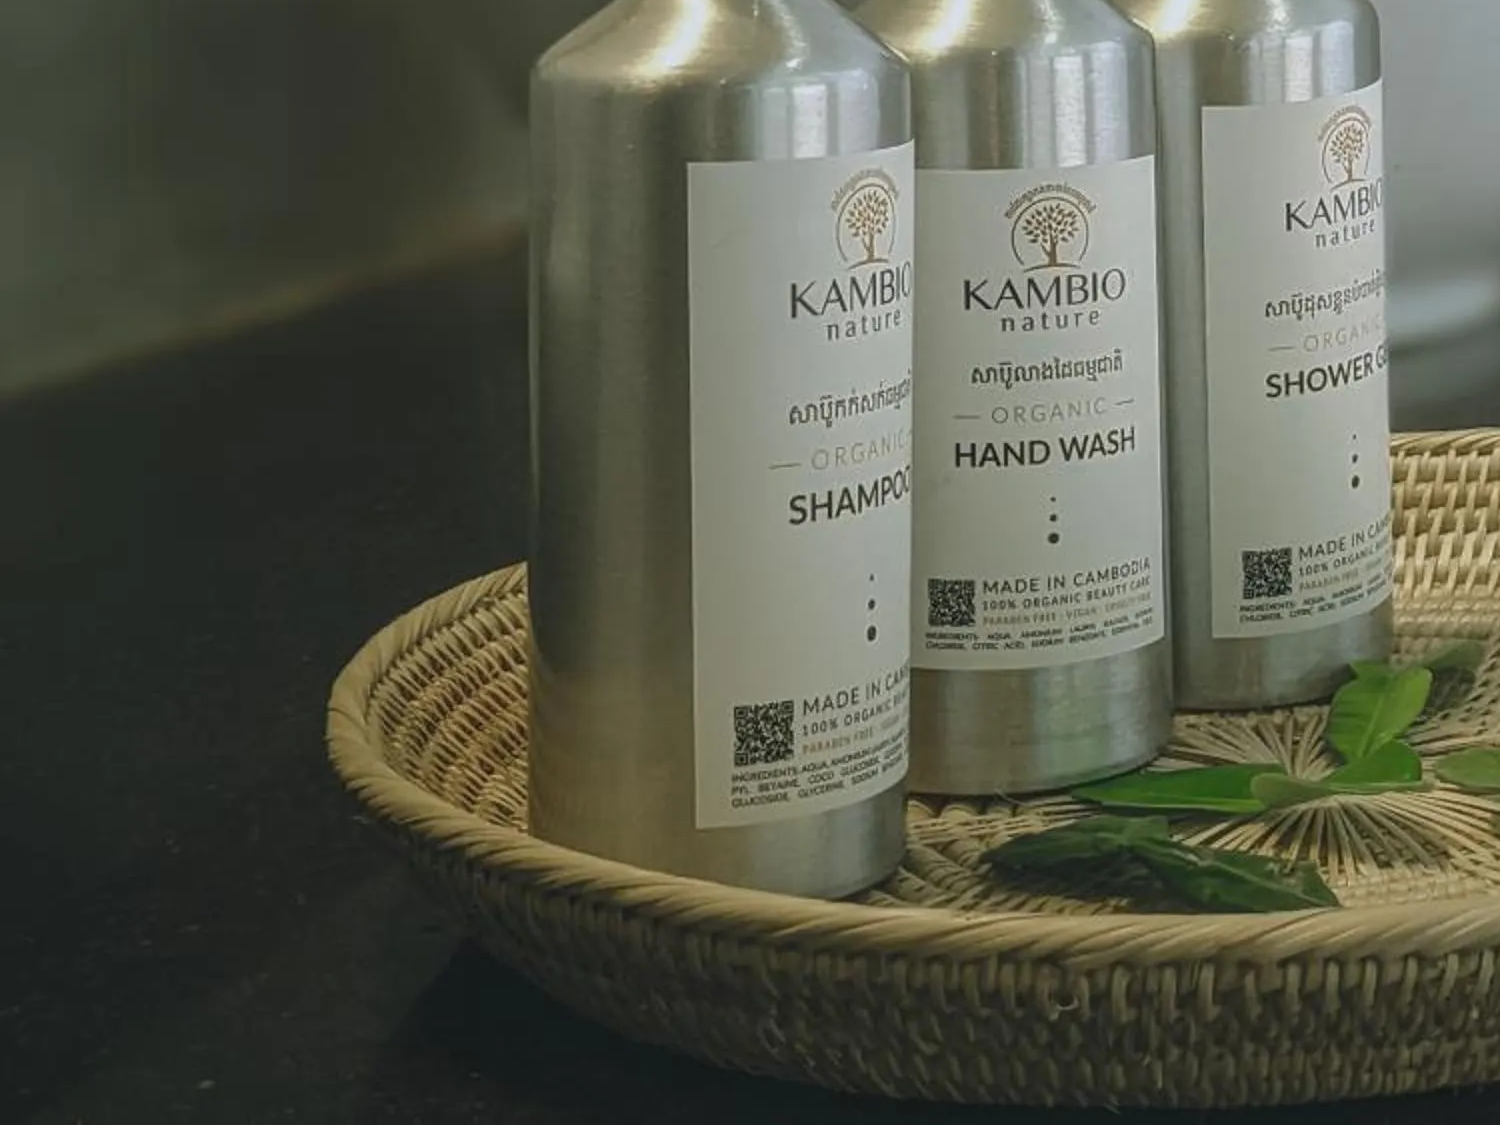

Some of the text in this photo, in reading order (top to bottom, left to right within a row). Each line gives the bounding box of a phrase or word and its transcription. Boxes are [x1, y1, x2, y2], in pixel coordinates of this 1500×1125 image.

[1315, 219, 1375, 248] nature
[963, 268, 1126, 311] KAMBIO
[826, 309, 901, 341] nature
[1001, 310, 1101, 332] nature
[1265, 352, 1374, 398] SHOWER
[991, 397, 1108, 424] ORGANIC
[955, 425, 1136, 468] HAND WASH
[1299, 536, 1347, 560] MADE
[1351, 530, 1365, 548] IN
[983, 556, 1151, 596] MADE IN CAMBODIA
[982, 599, 1017, 612] 100%
[1022, 591, 1082, 610] ORGANIC
[802, 687, 860, 715] MADE
[865, 680, 881, 701] IN
